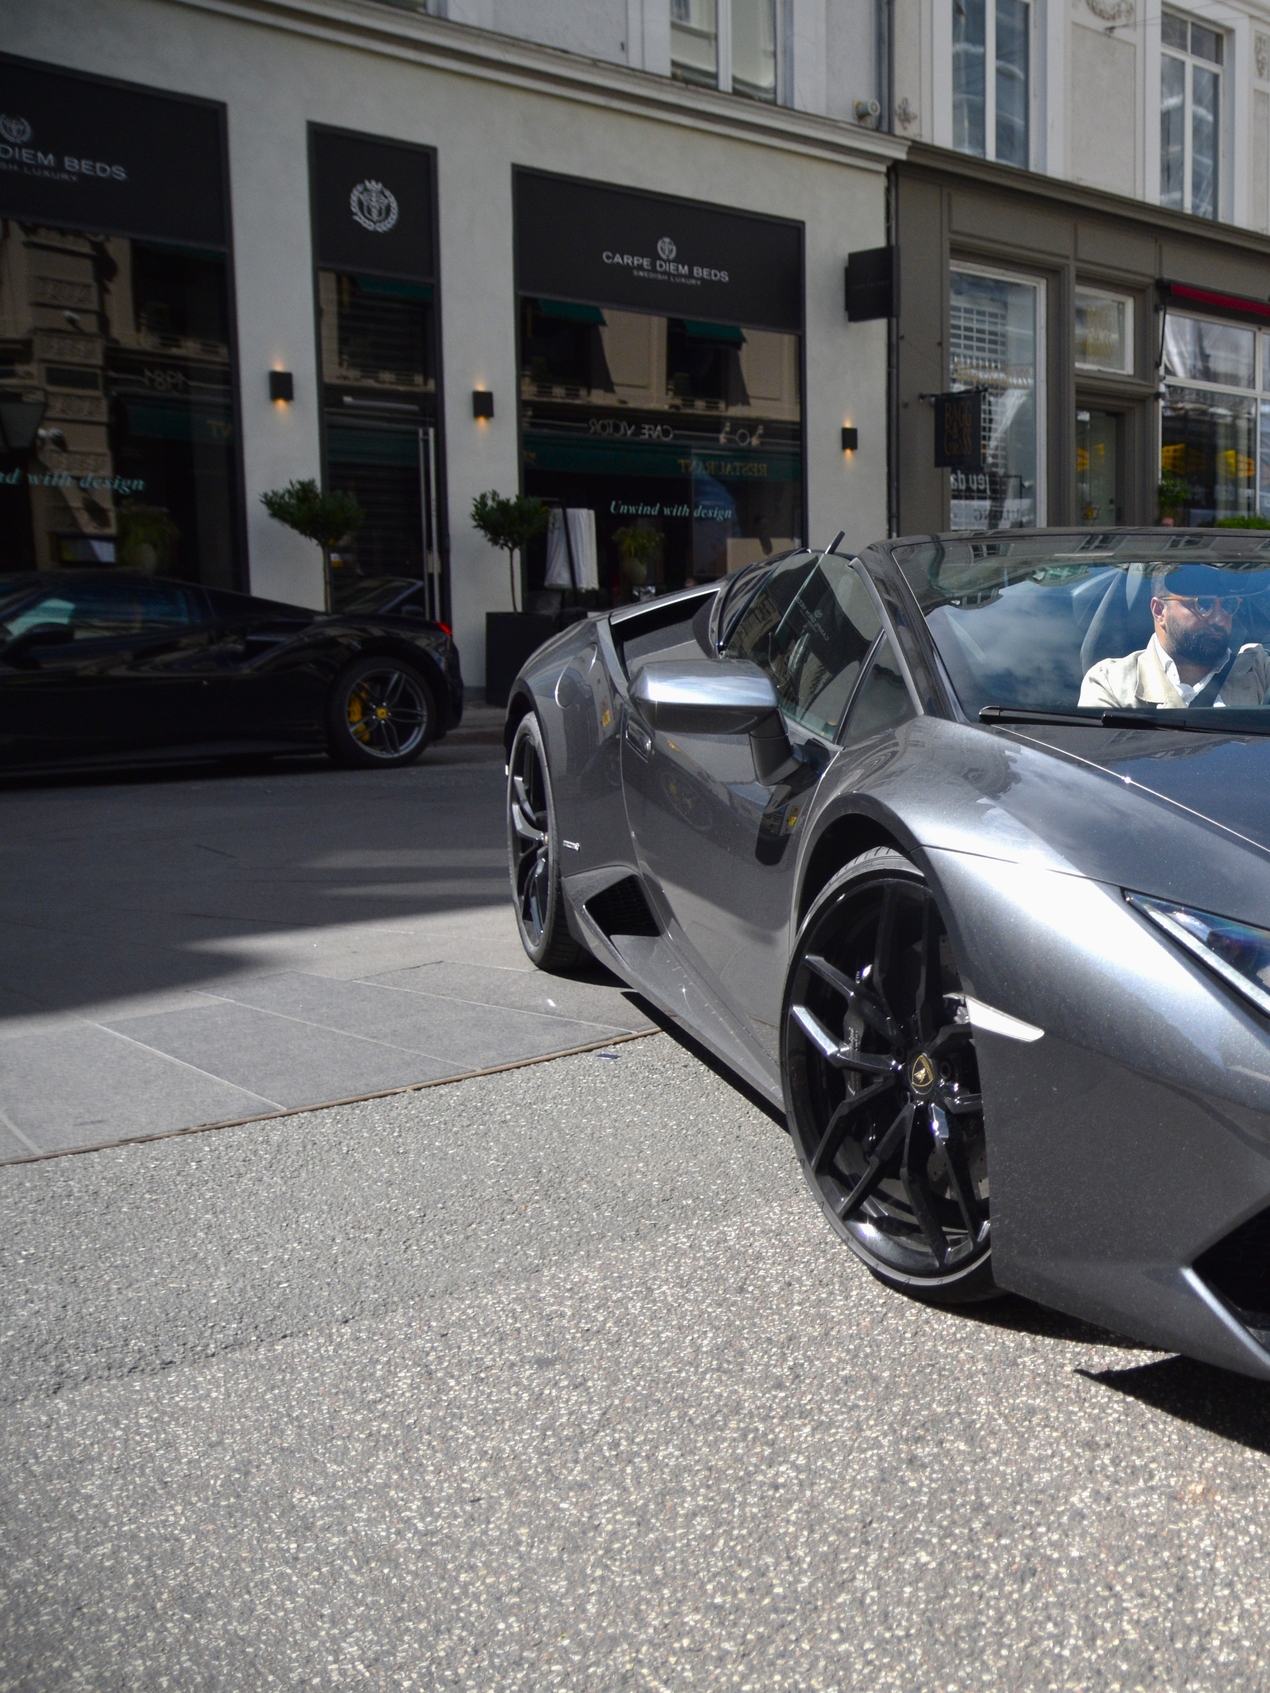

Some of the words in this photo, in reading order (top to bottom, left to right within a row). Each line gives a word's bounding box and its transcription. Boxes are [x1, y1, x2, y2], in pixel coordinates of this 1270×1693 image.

[0, 144, 56, 167] DIEM
[64, 156, 128, 181] BEDS
[23, 166, 79, 181] LUXURY
[602, 251, 652, 270] CARPE
[656, 260, 689, 275] DIEM
[693, 266, 730, 283] BEDS
[633, 269, 668, 281] SWEDISH
[670, 275, 702, 286] LUXURY
[28, 470, 73, 487] with
[79, 472, 146, 494] design
[610, 500, 660, 516] Unwind
[663, 501, 690, 517] with
[694, 502, 733, 521] design
